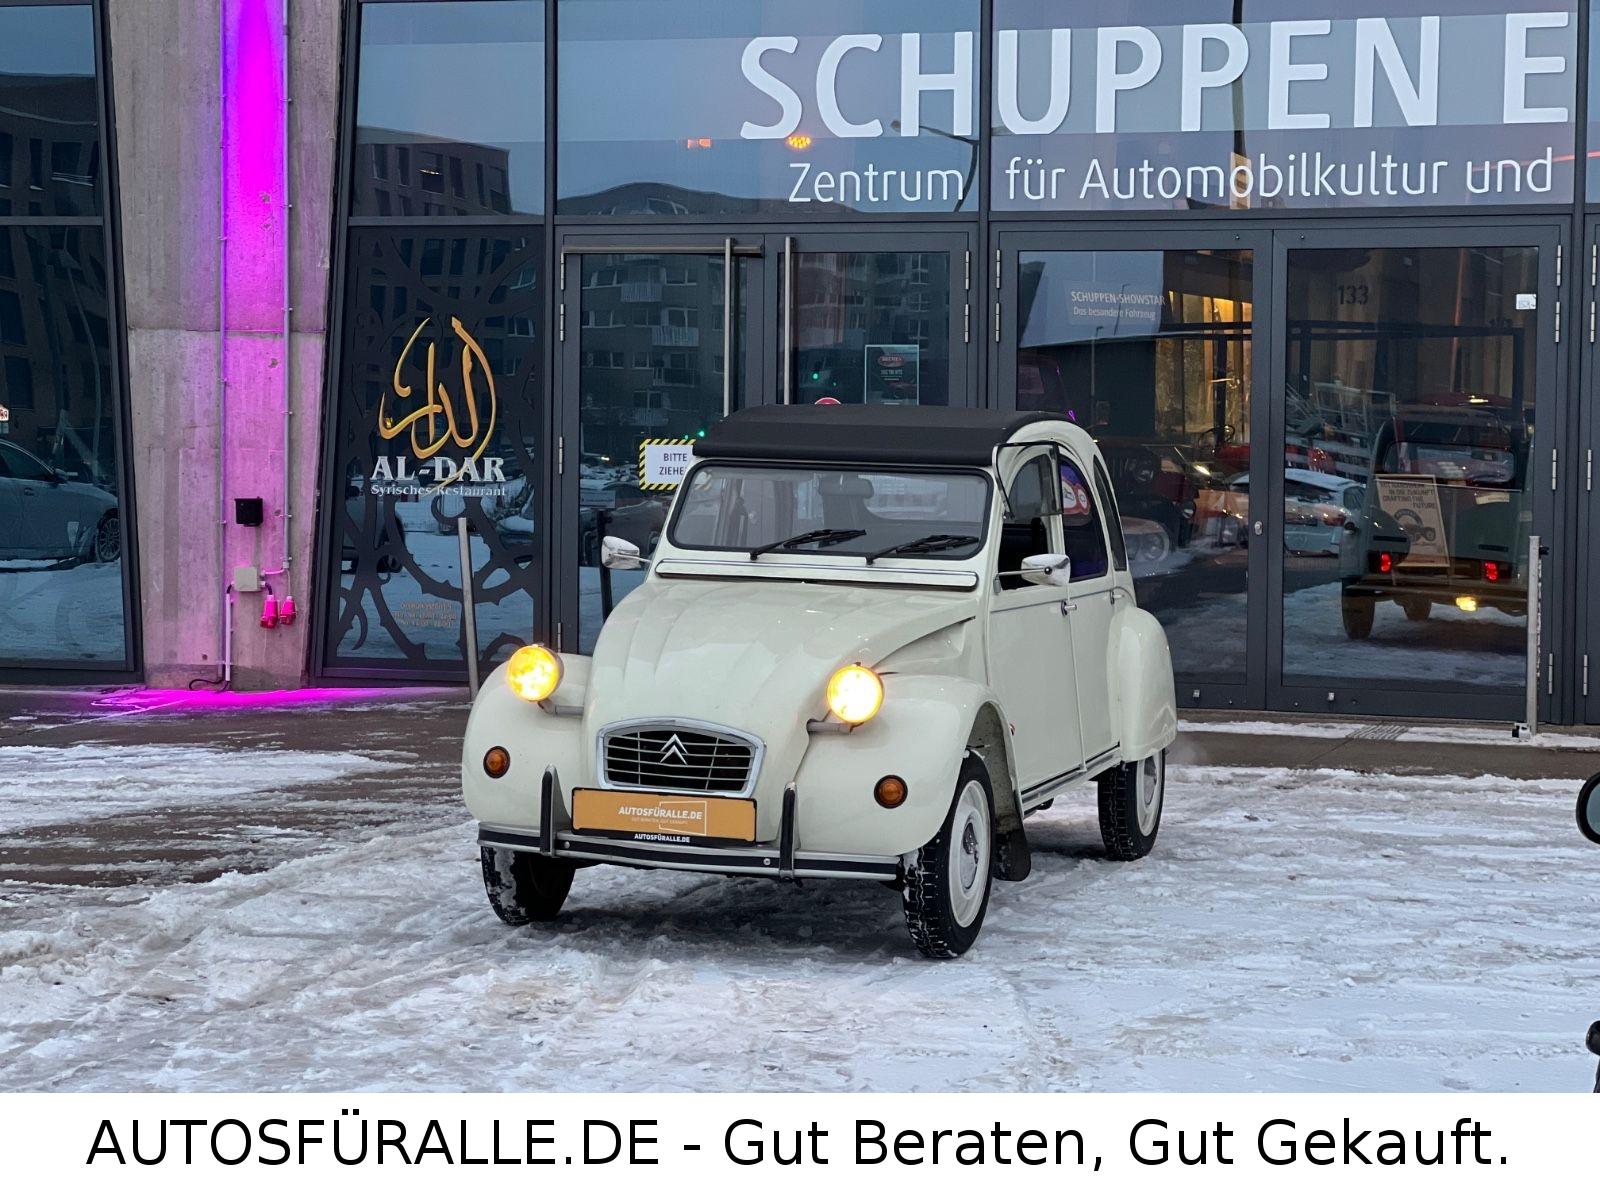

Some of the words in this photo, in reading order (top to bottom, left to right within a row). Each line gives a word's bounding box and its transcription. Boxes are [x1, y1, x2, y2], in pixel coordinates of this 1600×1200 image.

[740, 16, 1441, 140] SCHUPPEN
[788, 161, 965, 204] Zentrum
[1006, 155, 1066, 201] für
[1080, 151, 1448, 200] Automobilkultur
[1466, 147, 1553, 195] und
[1338, 285, 1369, 305] 133
[1073, 306, 1087, 316] Das
[663, 453, 687, 461] BITTE
[370, 455, 506, 482] AL-DAR
[659, 466, 687, 475] ZIEHE
[371, 484, 431, 497] Syrisches
[437, 485, 506, 496] Restaurant
[618, 807, 703, 820] AUTOSFÜRALLE.DE
[634, 833, 691, 843] AUTOSFÜRALLE.DE
